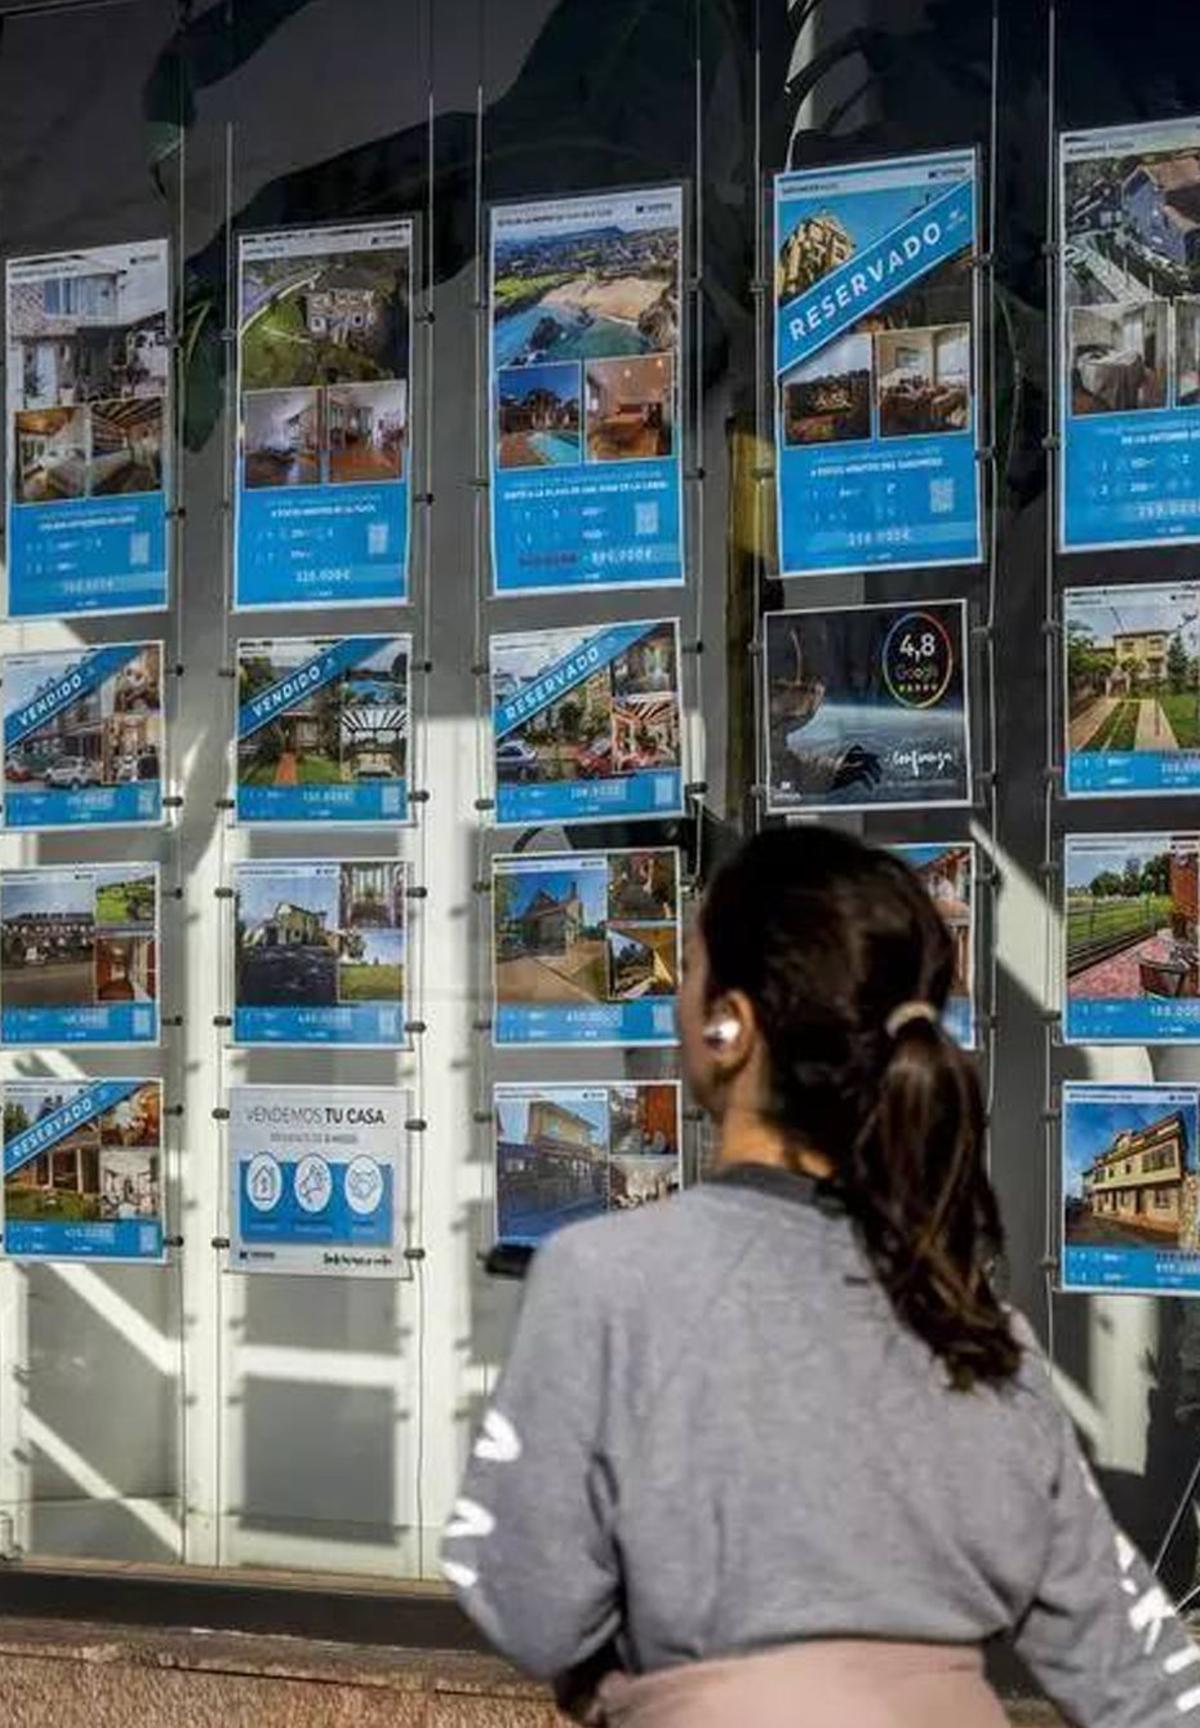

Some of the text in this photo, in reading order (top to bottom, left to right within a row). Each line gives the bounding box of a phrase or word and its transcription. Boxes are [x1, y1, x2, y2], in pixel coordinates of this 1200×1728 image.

[789, 223, 941, 341] RESERVADO
[900, 633, 935, 662] 4,8
[18, 673, 82, 726] VENDIDO
[252, 665, 321, 717] VENDIDO
[505, 647, 599, 721] RESERVADO
[13, 1098, 92, 1158] RESERVADO
[326, 1107, 344, 1124] TU
[346, 1108, 387, 1124] CASA
